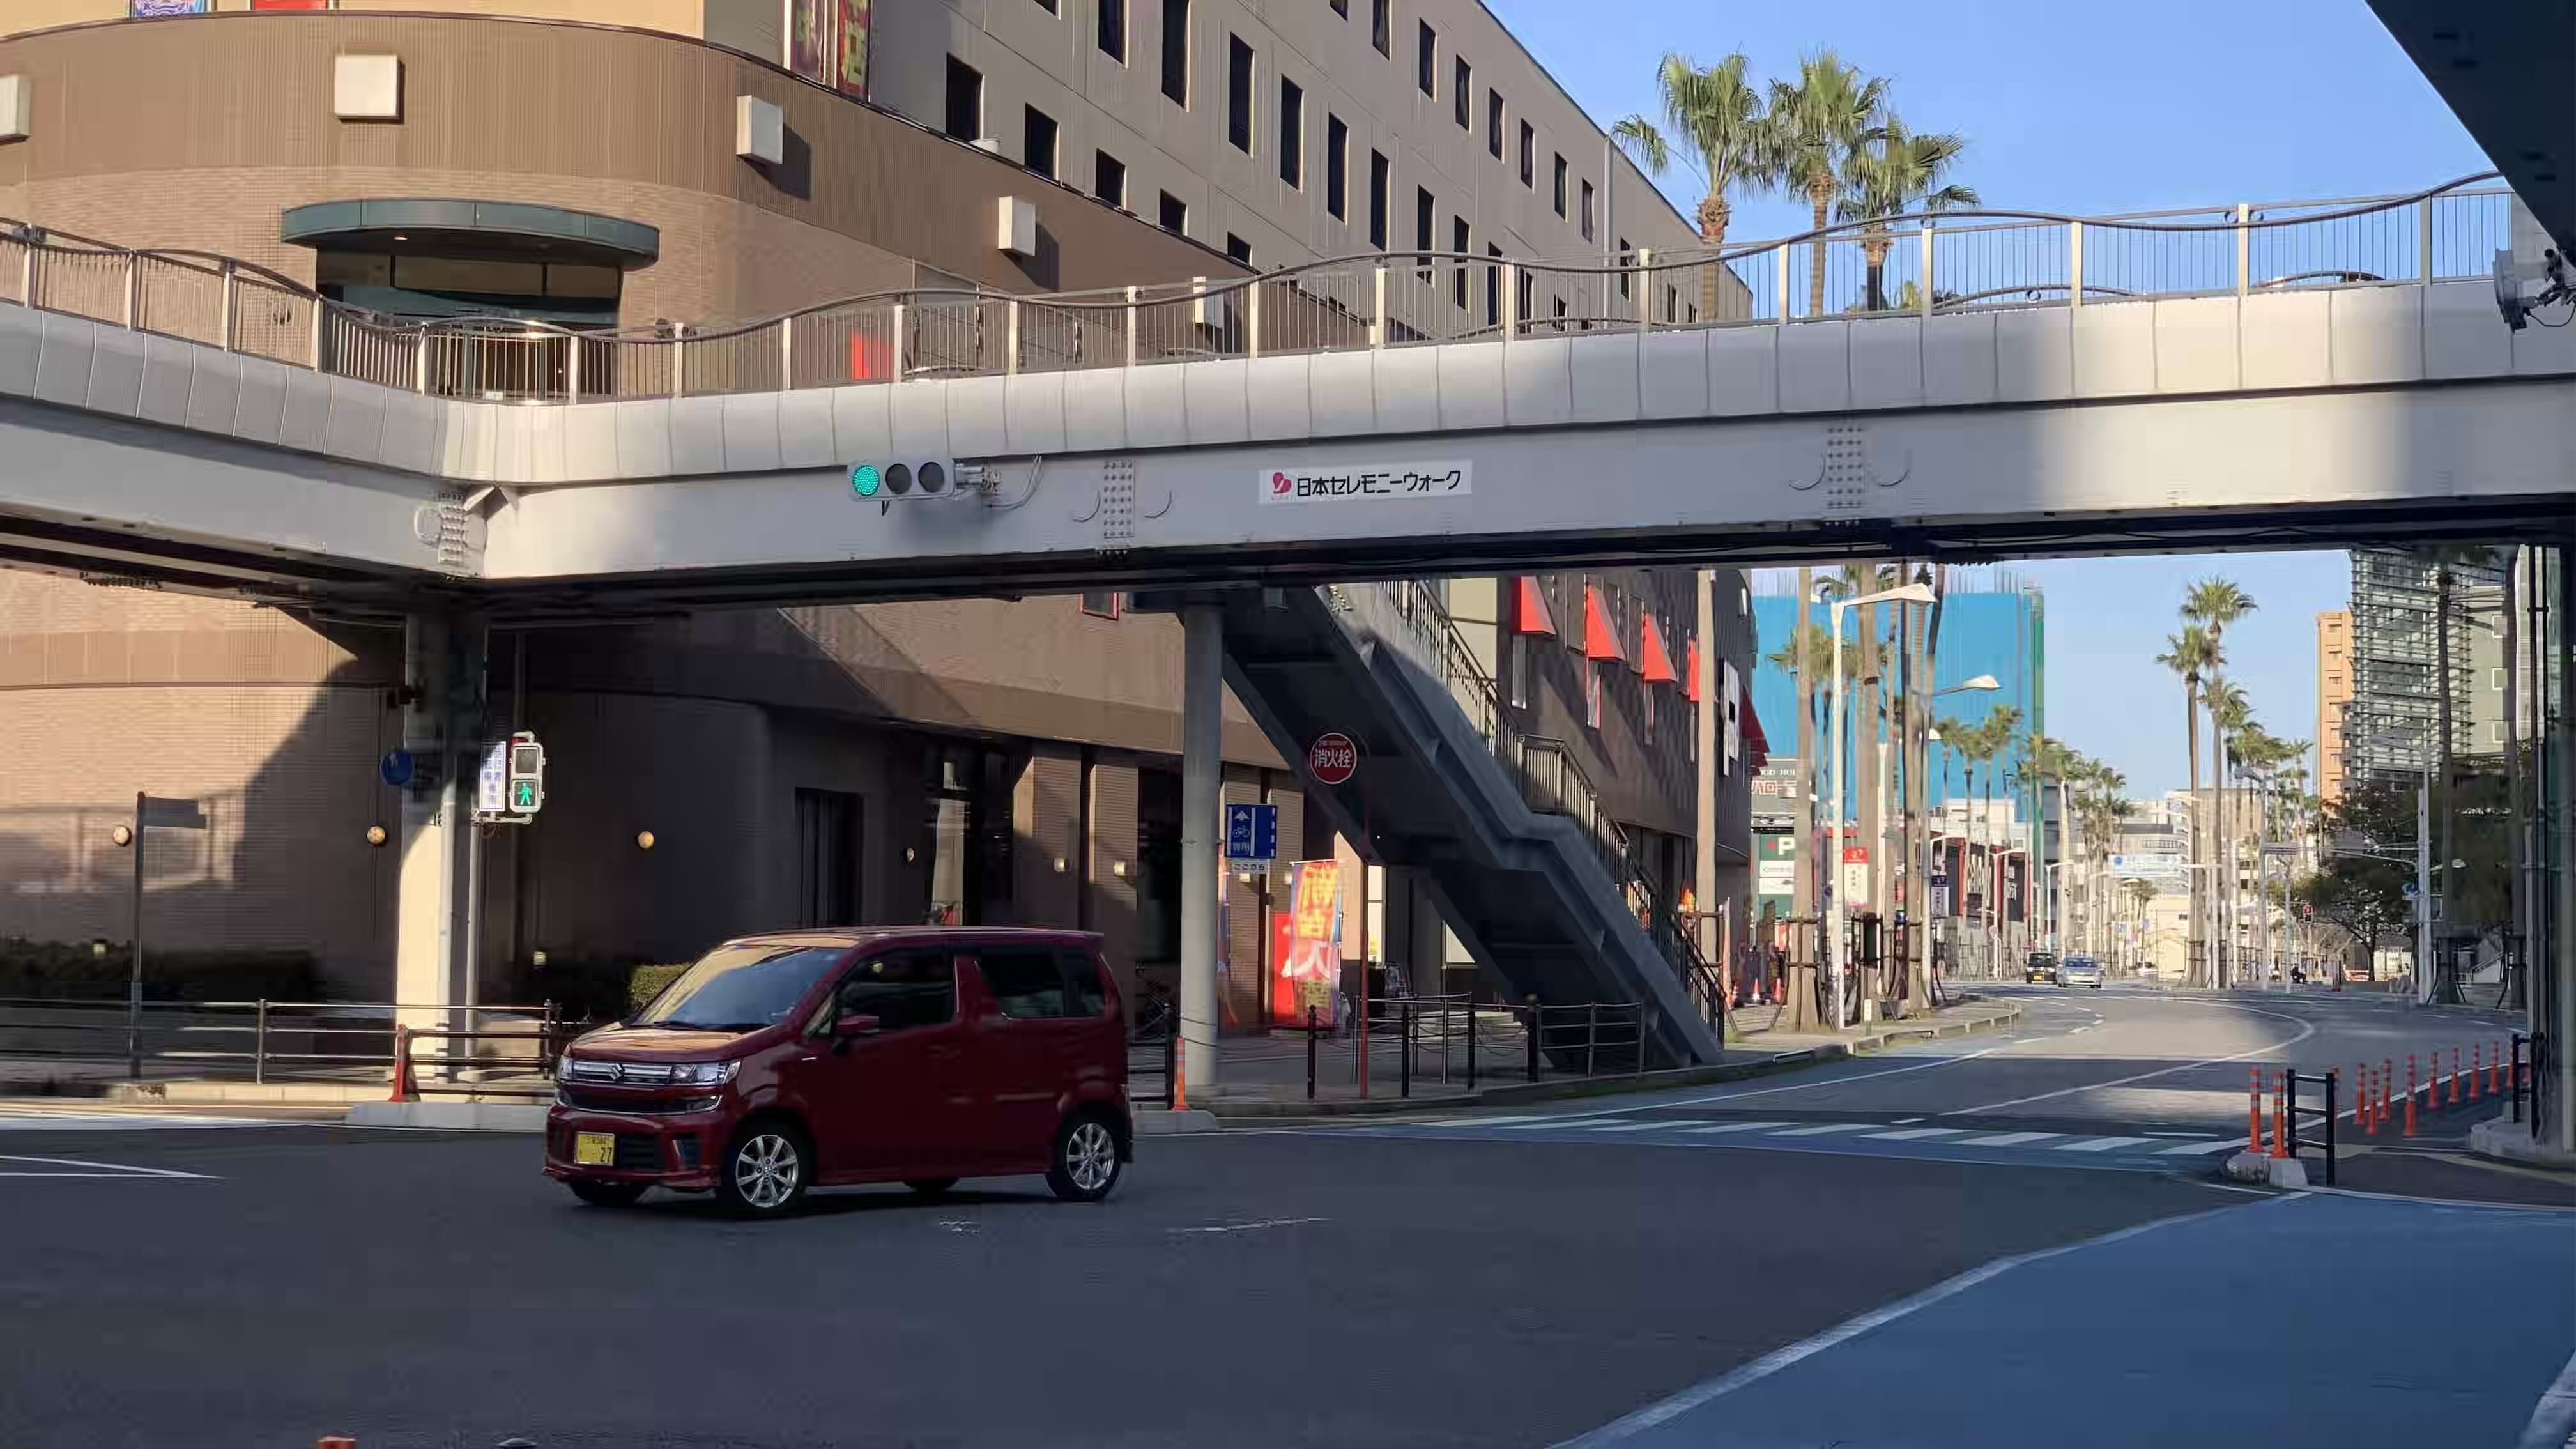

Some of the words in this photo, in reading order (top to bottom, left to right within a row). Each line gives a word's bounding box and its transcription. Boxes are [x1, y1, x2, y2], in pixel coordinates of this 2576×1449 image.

[1296, 470, 1462, 497] 日本セレモニーウォーク
[1314, 748, 1353, 768] 消火栓
[1778, 836, 1795, 855] P
